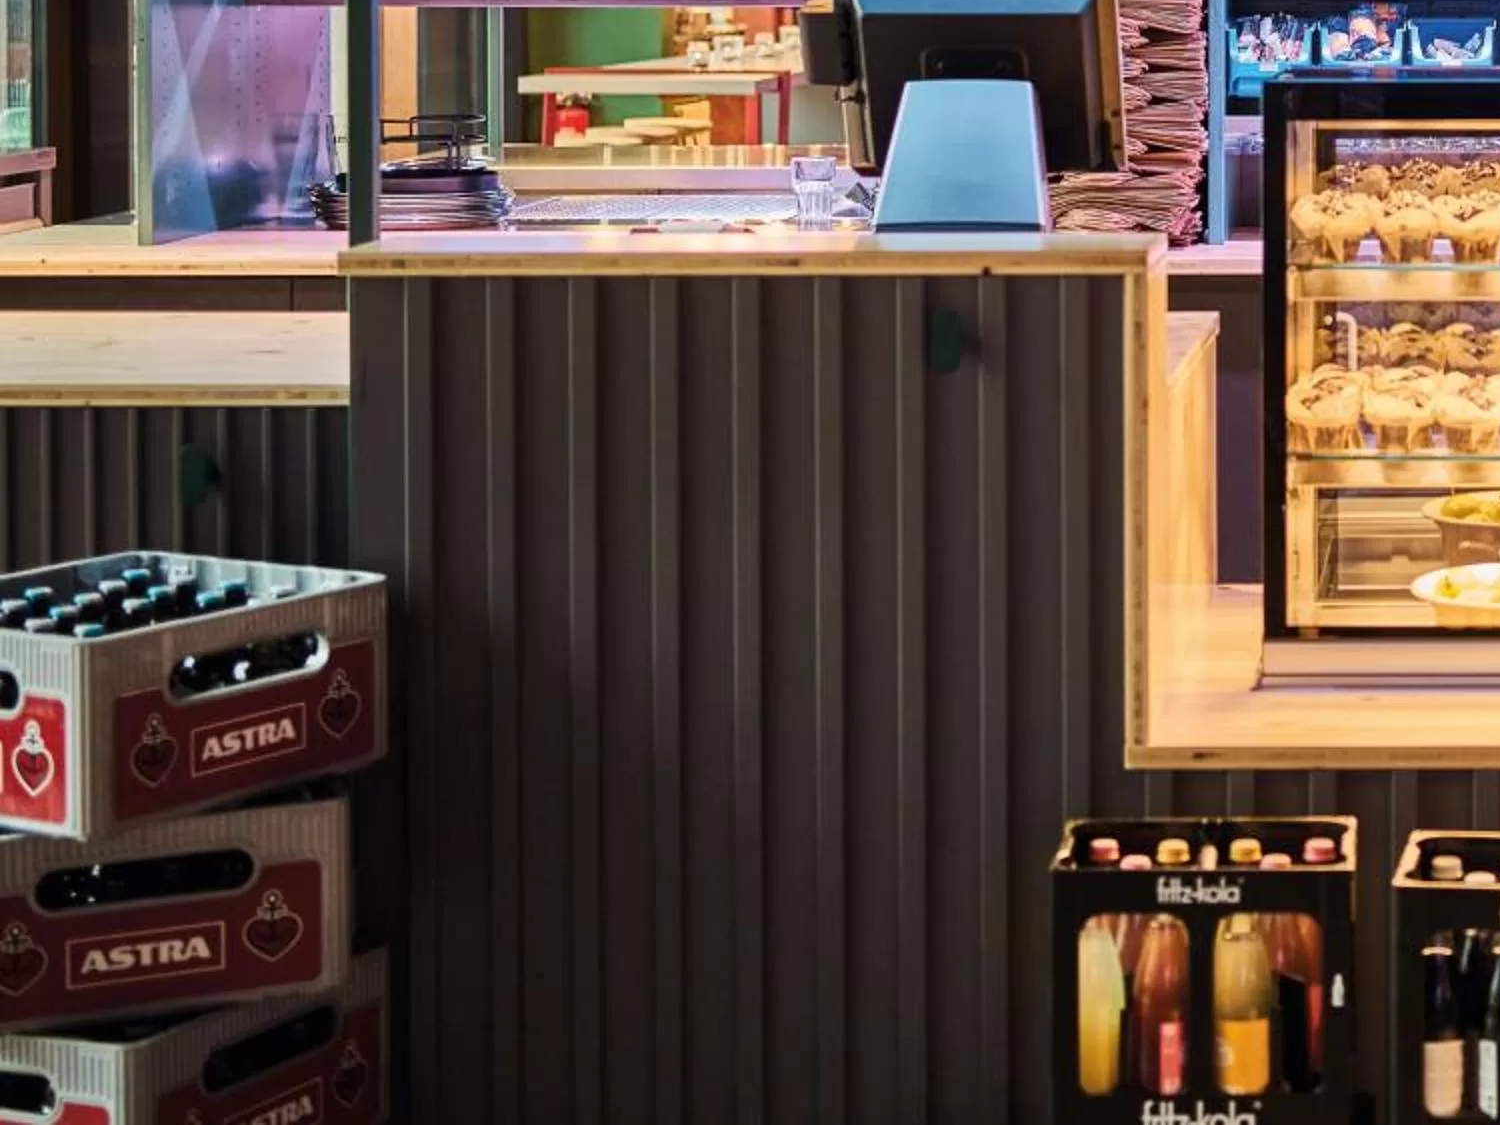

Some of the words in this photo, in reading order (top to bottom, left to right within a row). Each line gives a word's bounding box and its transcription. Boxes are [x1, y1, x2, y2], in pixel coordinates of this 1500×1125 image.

[201, 716, 297, 762] ASTRA
[1156, 876, 1241, 904] fritz-kola
[80, 935, 212, 975] ASTRA
